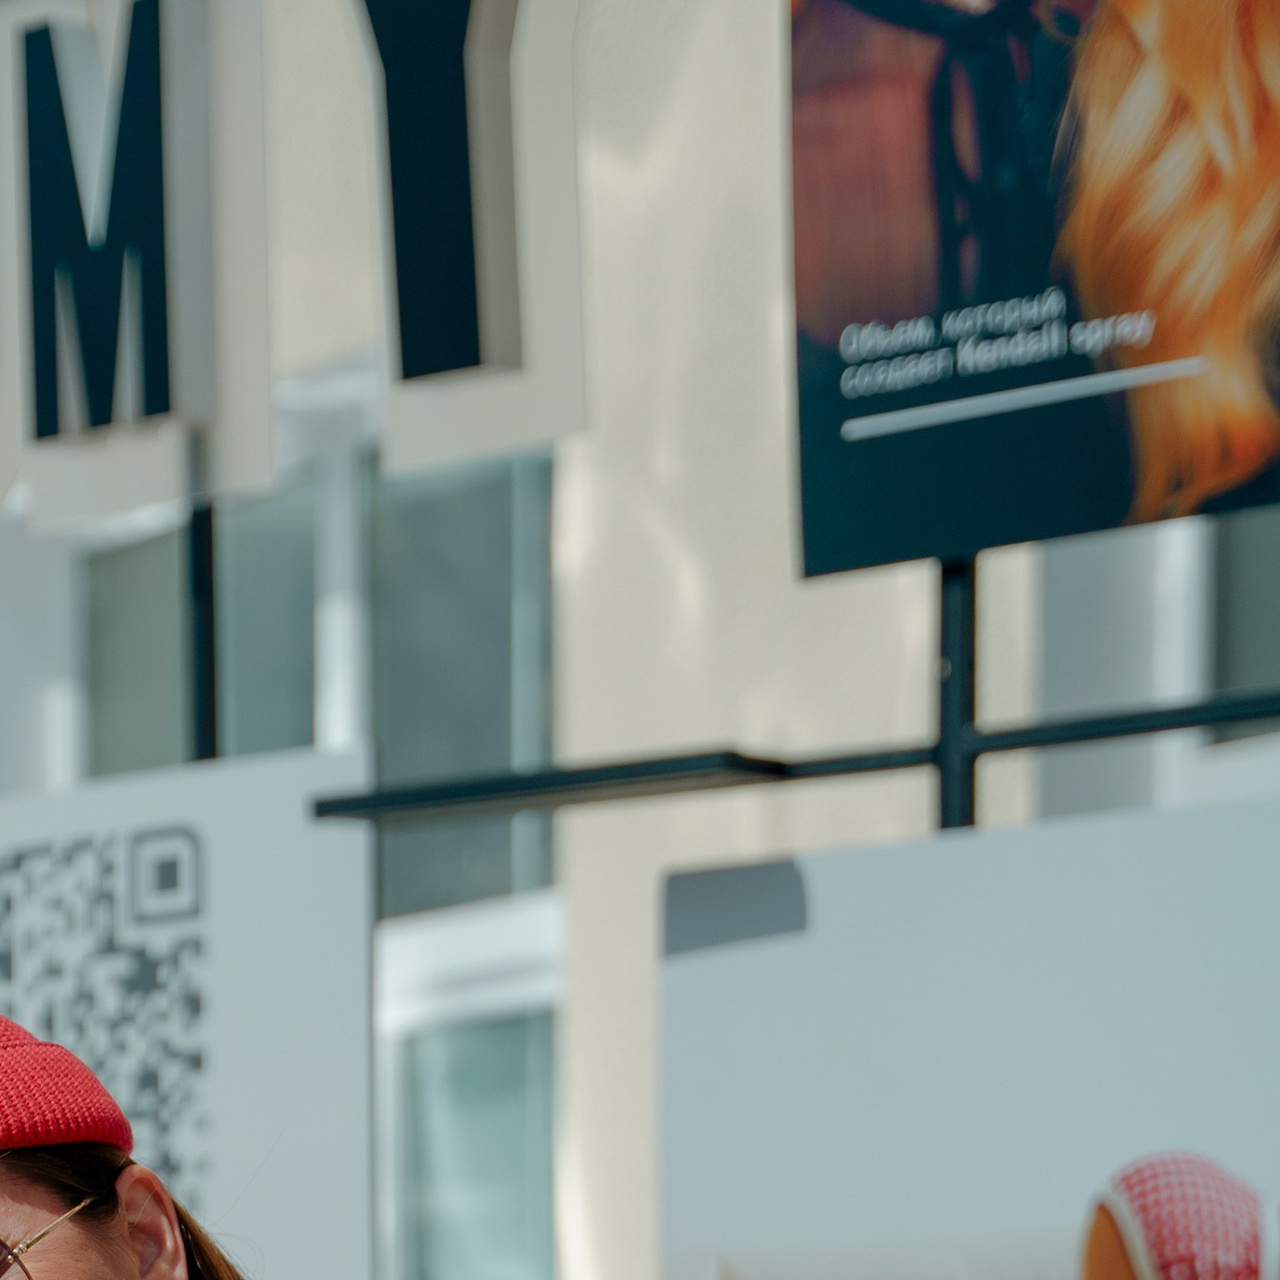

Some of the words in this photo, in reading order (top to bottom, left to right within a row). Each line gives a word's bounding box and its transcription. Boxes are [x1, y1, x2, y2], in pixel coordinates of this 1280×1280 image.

[942, 286, 1066, 339] который
[957, 319, 1067, 376] Kendall
[1070, 309, 1155, 357] spray
